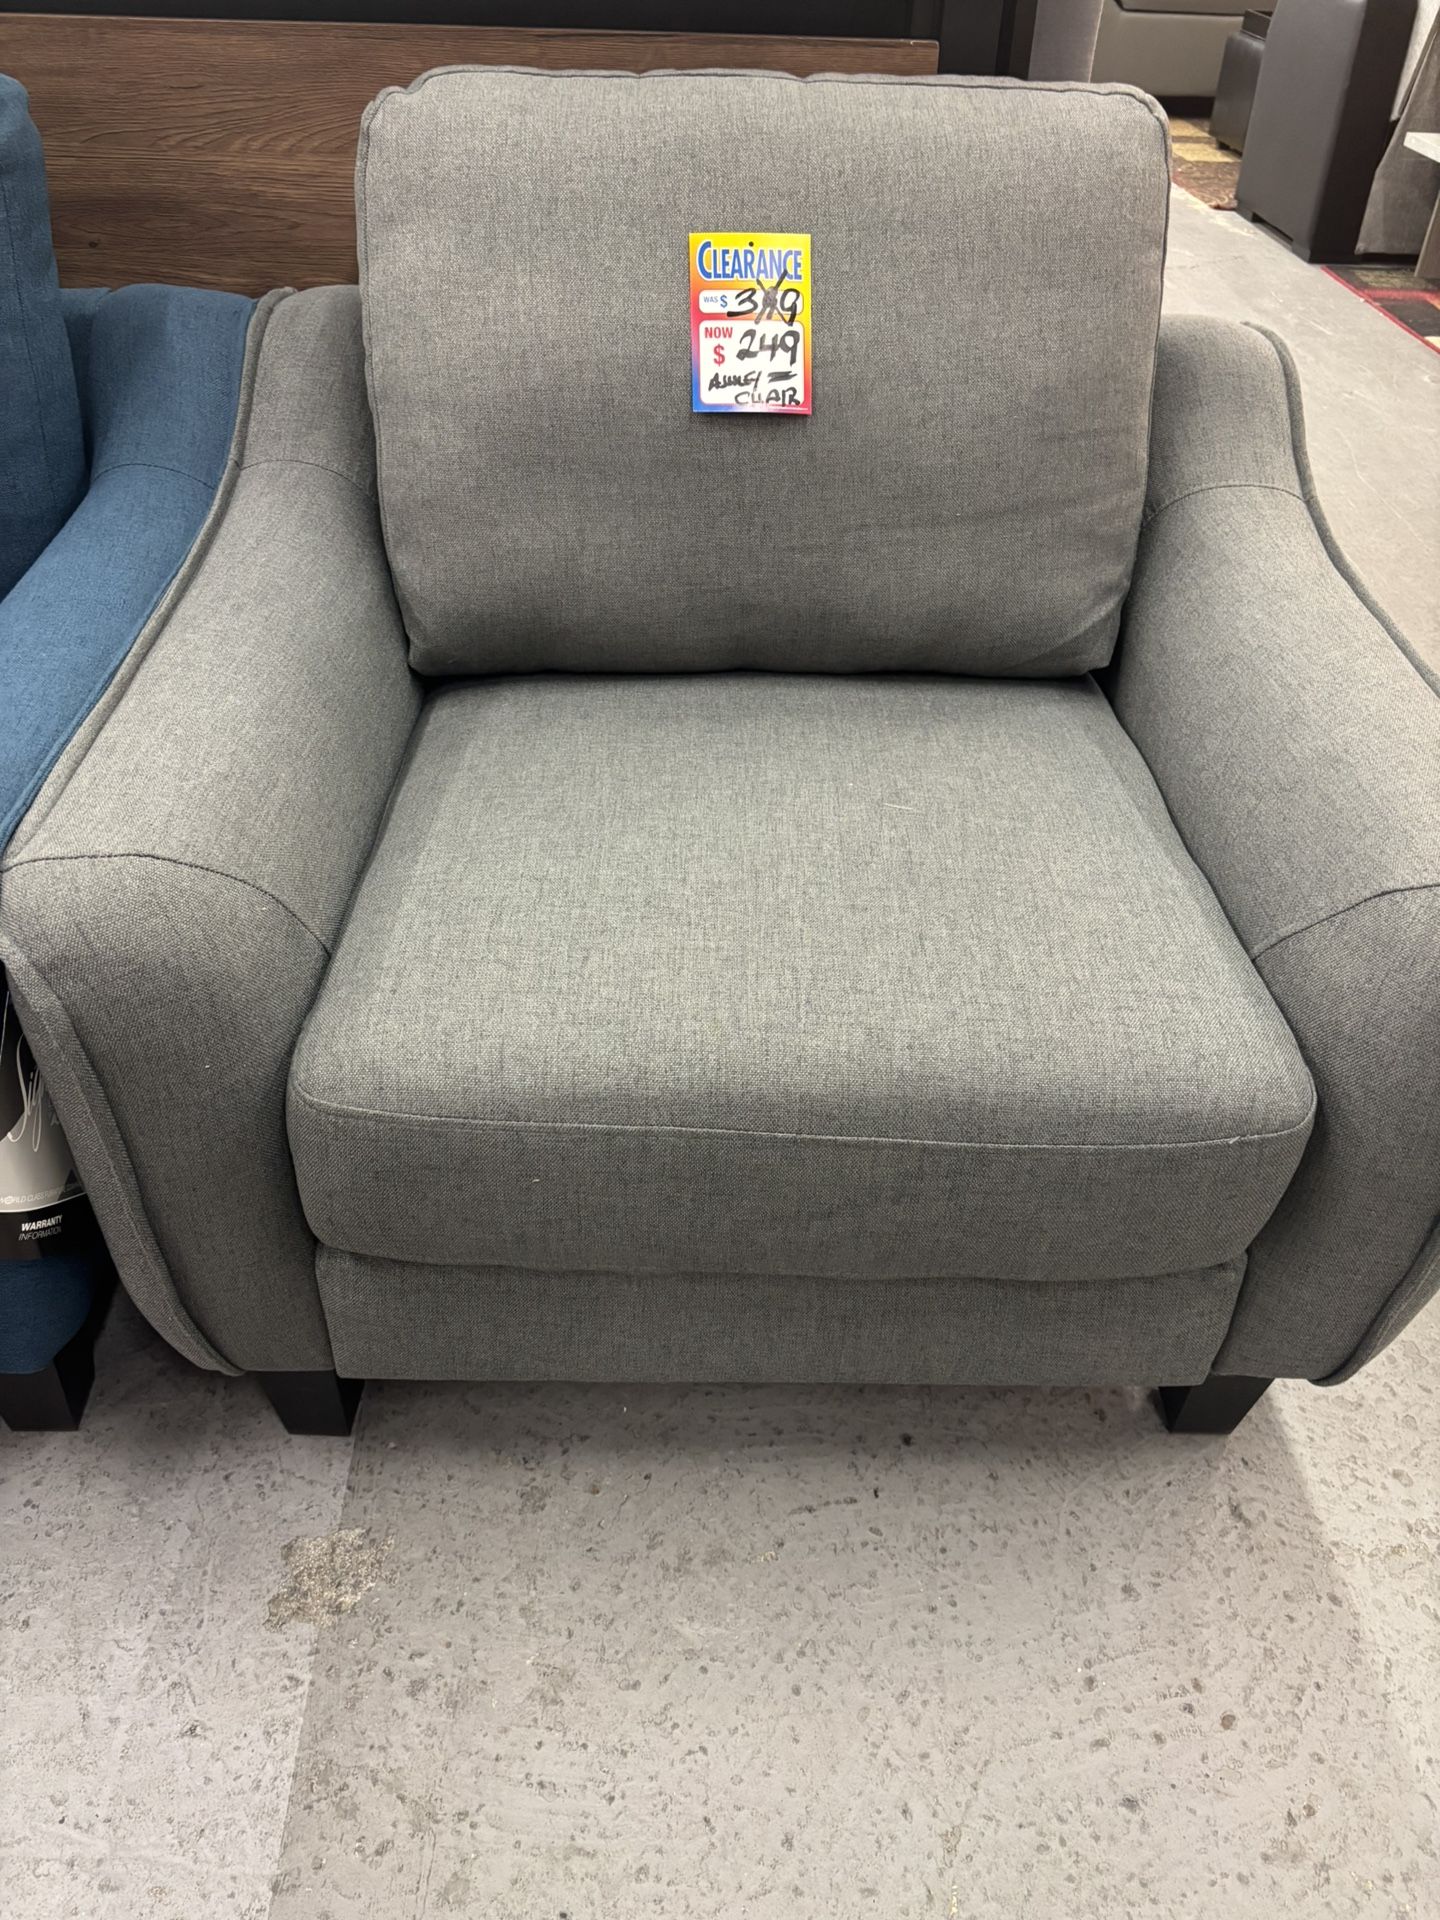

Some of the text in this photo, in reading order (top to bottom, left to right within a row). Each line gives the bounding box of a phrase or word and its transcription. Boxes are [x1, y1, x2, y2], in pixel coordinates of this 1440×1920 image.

[697, 240, 802, 280] CLEARANCE
[727, 287, 800, 326] 39
[704, 327, 733, 339] NOW
[736, 328, 800, 366] 249
[18, 1226, 62, 1241] INFORMATION
[21, 1214, 63, 1232] WARRANTY
